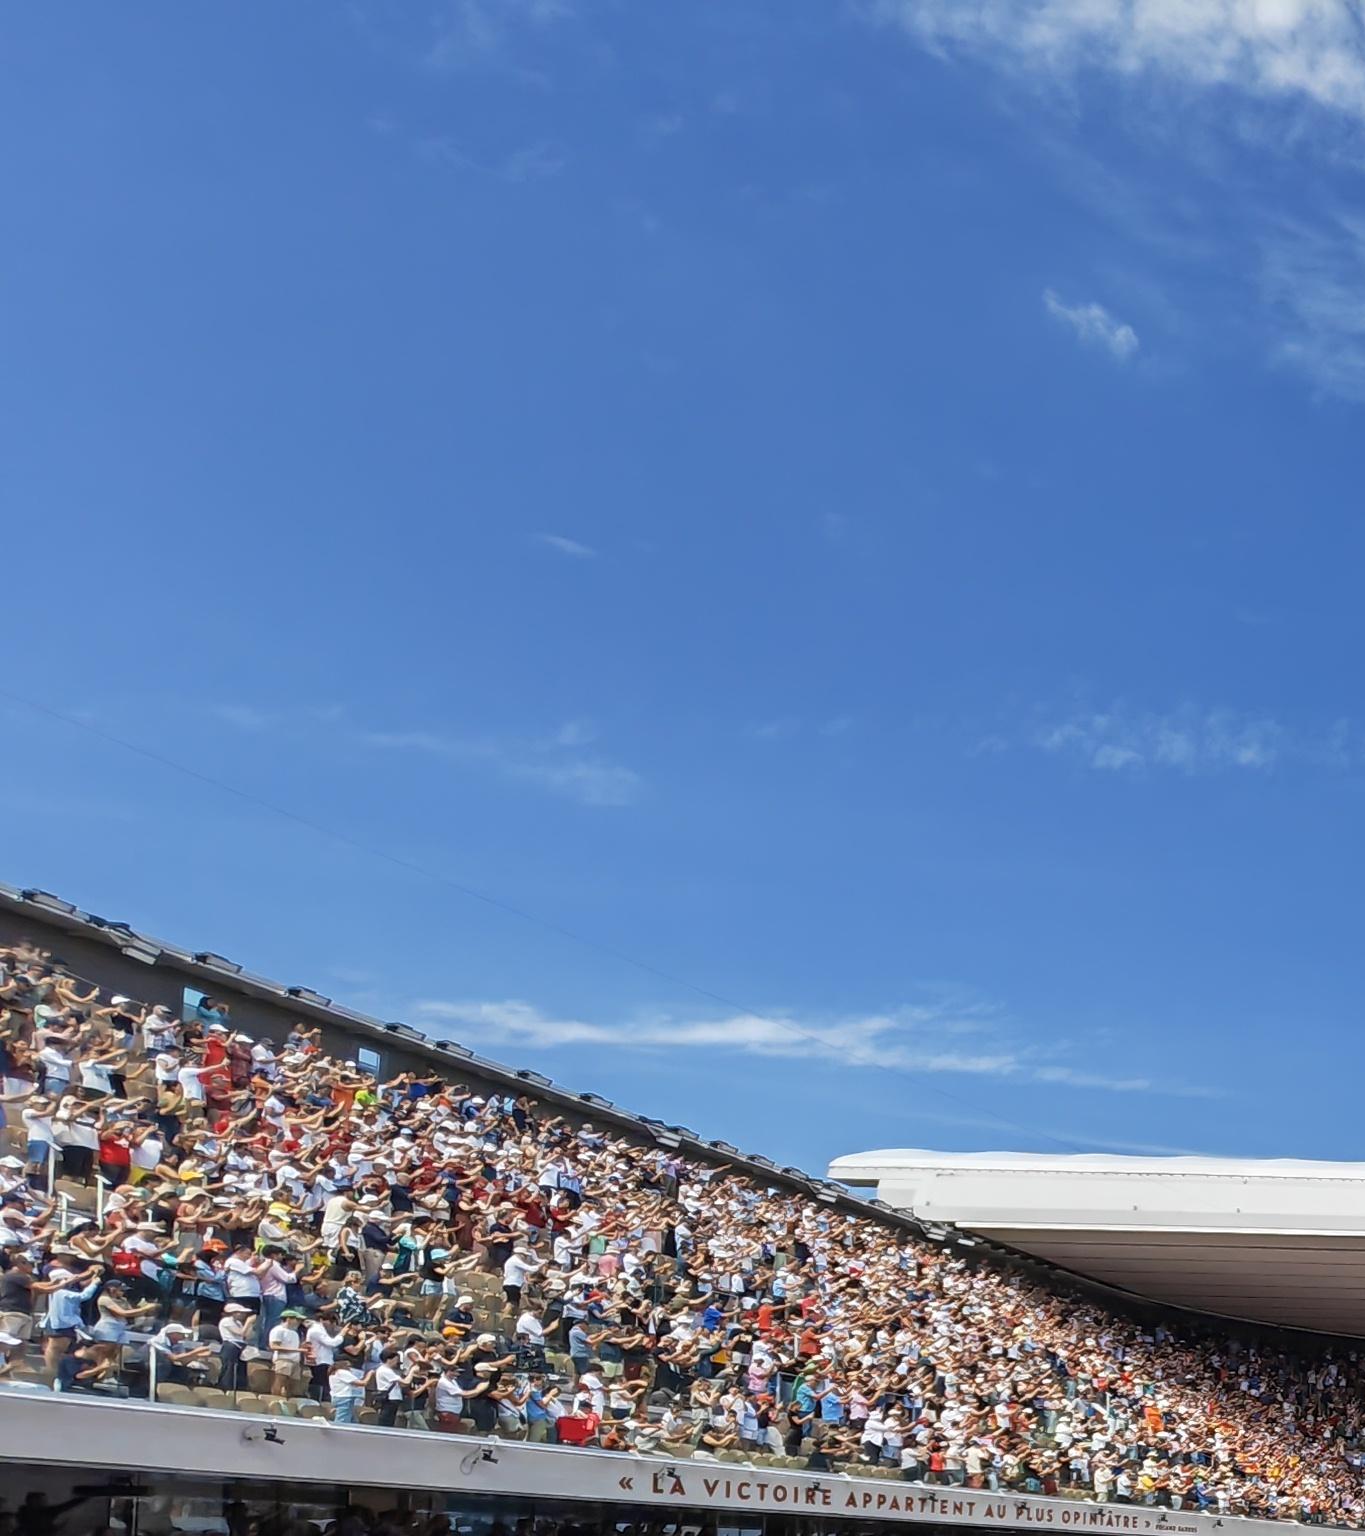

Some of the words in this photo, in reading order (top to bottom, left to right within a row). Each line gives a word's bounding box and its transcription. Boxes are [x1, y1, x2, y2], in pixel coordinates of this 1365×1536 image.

[652, 1472, 686, 1496] LA
[703, 1478, 832, 1506] VICTOIRE
[845, 1491, 976, 1517] APPARTIENT
[984, 1504, 1007, 1519] AU
[1016, 1505, 1053, 1522] PLUS
